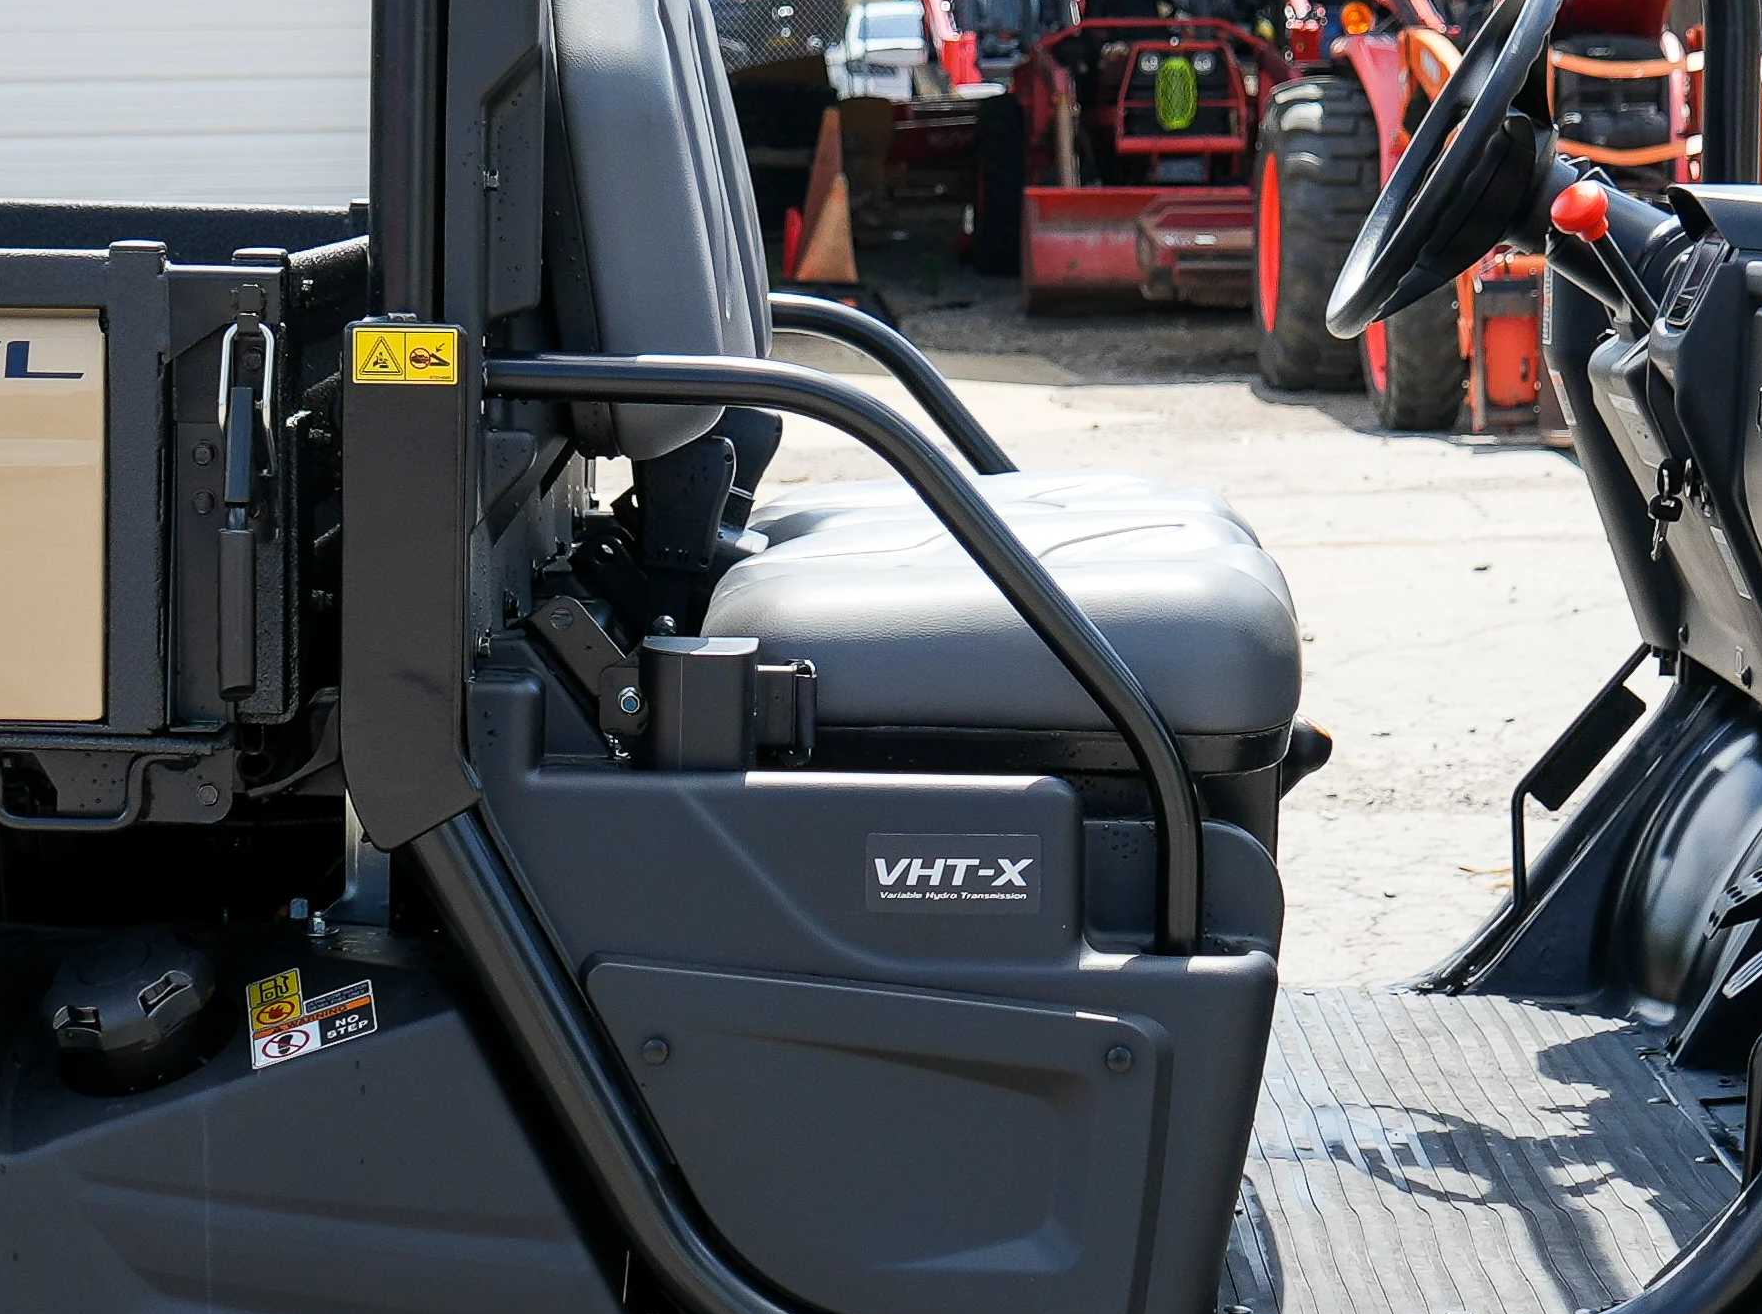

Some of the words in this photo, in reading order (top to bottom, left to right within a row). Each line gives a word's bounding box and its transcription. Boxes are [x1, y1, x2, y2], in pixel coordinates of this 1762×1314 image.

[874, 858, 1034, 886] VHT-X
[925, 891, 957, 901] Hydro
[335, 1014, 359, 1027] NO
[326, 1020, 369, 1039] STEP
